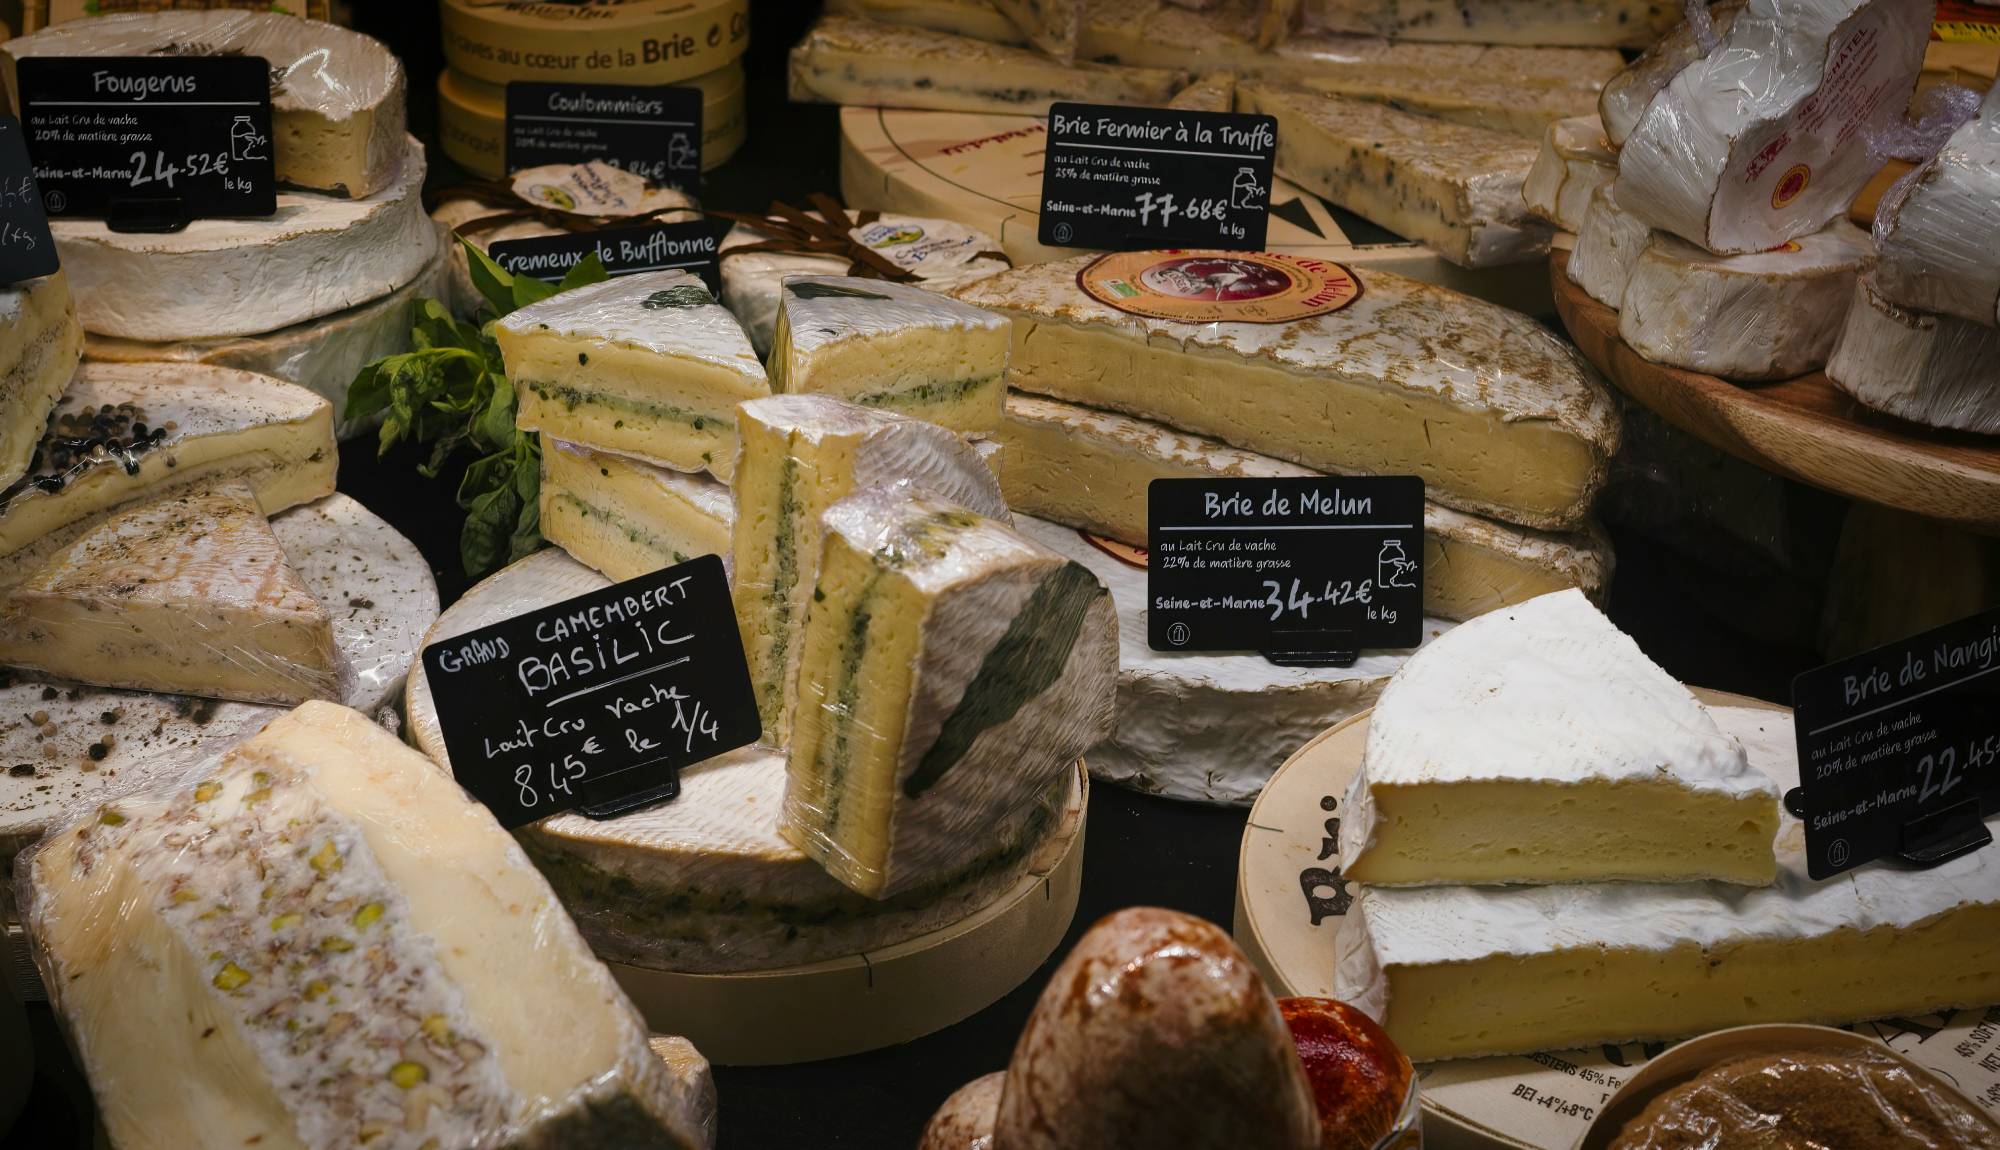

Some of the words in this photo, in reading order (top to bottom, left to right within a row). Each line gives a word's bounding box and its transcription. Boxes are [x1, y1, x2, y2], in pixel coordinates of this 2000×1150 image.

[497, 48, 519, 66] au
[525, 51, 580, 70] cœur
[585, 48, 612, 69] de
[619, 48, 636, 66] la
[641, 34, 696, 65] Brie
[92, 70, 197, 101] Fougerus
[548, 92, 664, 116] Coulommiers
[31, 116, 45, 125] au
[48, 114, 69, 125] Lait
[93, 113, 105, 125] de
[108, 113, 138, 125] vache
[35, 130, 60, 142] 20%
[62, 130, 75, 142] de
[77, 130, 118, 142] matière
[120, 132, 153, 145] grasse
[1053, 115, 1091, 136] Brie
[1096, 117, 1172, 141] Fermier
[1175, 121, 1189, 143] à
[1194, 122, 1213, 144] la
[1219, 123, 1274, 151] Truffe
[32, 165, 133, 180] Seine-et-Marne
[1054, 155, 1067, 164] au
[1069, 154, 1089, 165] Lait
[1091, 155, 1108, 167] Cru
[1109, 156, 1121, 168] de
[224, 177, 234, 190] le
[237, 176, 252, 193] kg
[1054, 167, 1078, 179] 25%
[1079, 168, 1091, 181] de
[1046, 200, 1137, 218] Seine-et-Marne
[1219, 223, 1229, 235] le
[1231, 223, 1245, 239] kg
[495, 250, 583, 272] Cremeux
[1204, 491, 1253, 519] Brie
[1262, 488, 1291, 516] de
[1300, 488, 1372, 515] Melun
[1160, 543, 1175, 551] au
[1179, 540, 1203, 551] Lait
[1205, 541, 1226, 551] Cru
[1228, 539, 1242, 551] de
[1245, 540, 1277, 551] vache
[1163, 556, 1190, 569] 22%
[1193, 557, 1206, 568] de
[1209, 556, 1253, 568] matière
[1256, 559, 1291, 572] grasse
[1155, 595, 1265, 609] Seine-et-Marne
[1262, 577, 1372, 622] 34.42€
[439, 636, 510, 673] GRAND
[535, 575, 692, 643] CAMEMBERT
[1367, 606, 1377, 620] le
[1381, 605, 1397, 623] kg
[1843, 666, 1892, 706] Brie
[1899, 651, 1926, 686] de
[1933, 625, 2000, 674] Nangi
[625, 728, 661, 754] le
[672, 699, 719, 753] 1/4
[1811, 748, 1827, 761] au
[1830, 736, 1851, 754] Lait
[1855, 730, 1874, 745] Cru
[1876, 722, 1890, 738] de
[1891, 712, 1922, 732] vache
[485, 719, 538, 759] Lait
[1816, 758, 1843, 780] 20%
[1844, 755, 1858, 771] de
[1860, 742, 1901, 766] matière
[1903, 728, 1937, 754] grasse
[1813, 784, 1917, 831] Seine-et-Marne
[1954, 1040, 1981, 1058] 45%
[1969, 1021, 1997, 1043] SOFT
[1579, 1068, 1604, 1085] 45%
[1512, 1083, 1538, 1102] BEI
